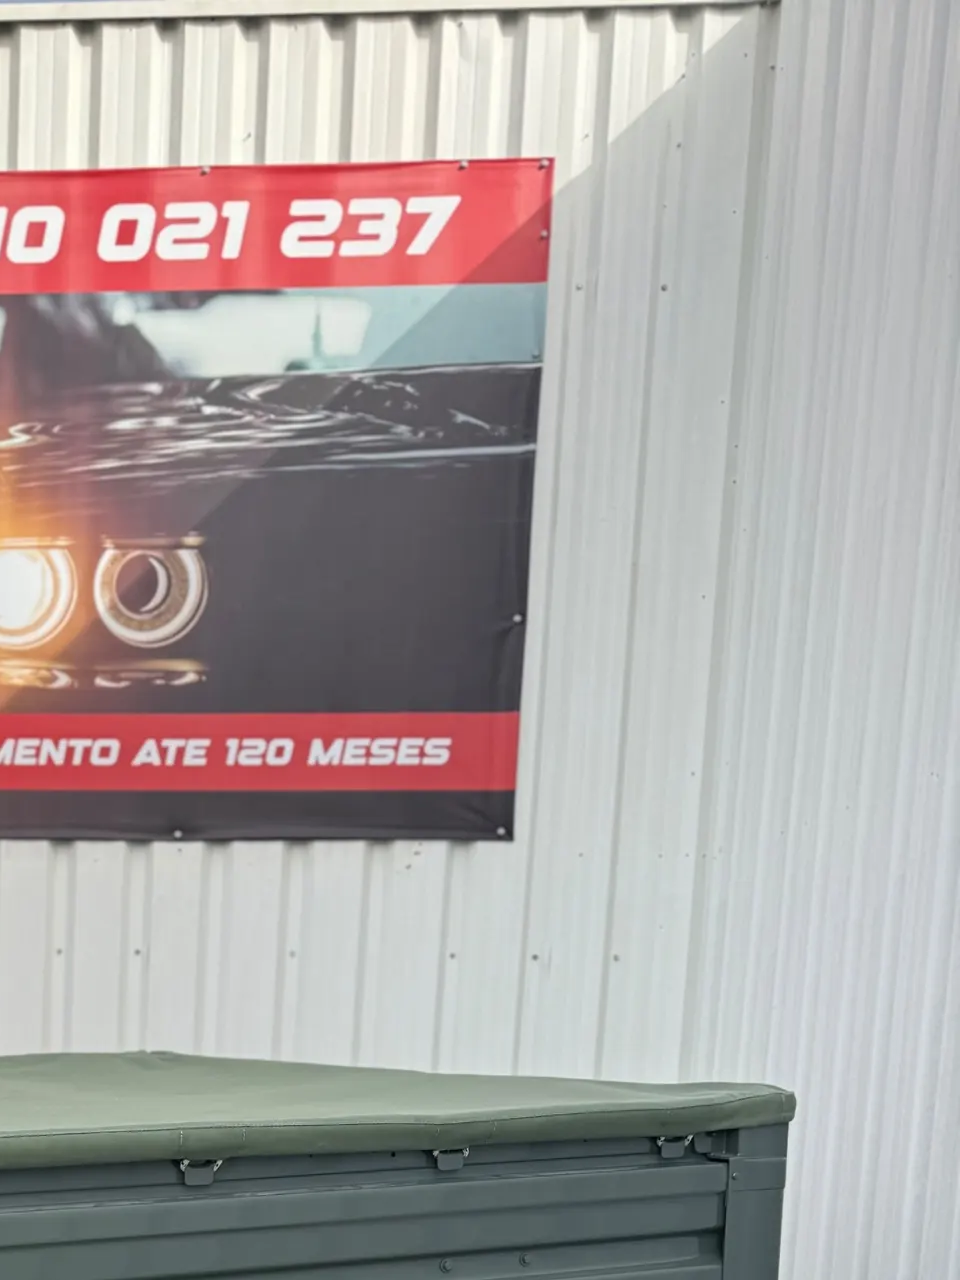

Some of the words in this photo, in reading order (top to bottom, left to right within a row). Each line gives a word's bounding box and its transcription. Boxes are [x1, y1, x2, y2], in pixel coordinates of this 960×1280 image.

[96, 200, 250, 263] 021
[280, 195, 461, 258] 237
[131, 738, 211, 767] ATE
[226, 737, 294, 766] 120
[307, 737, 452, 766] MESES
